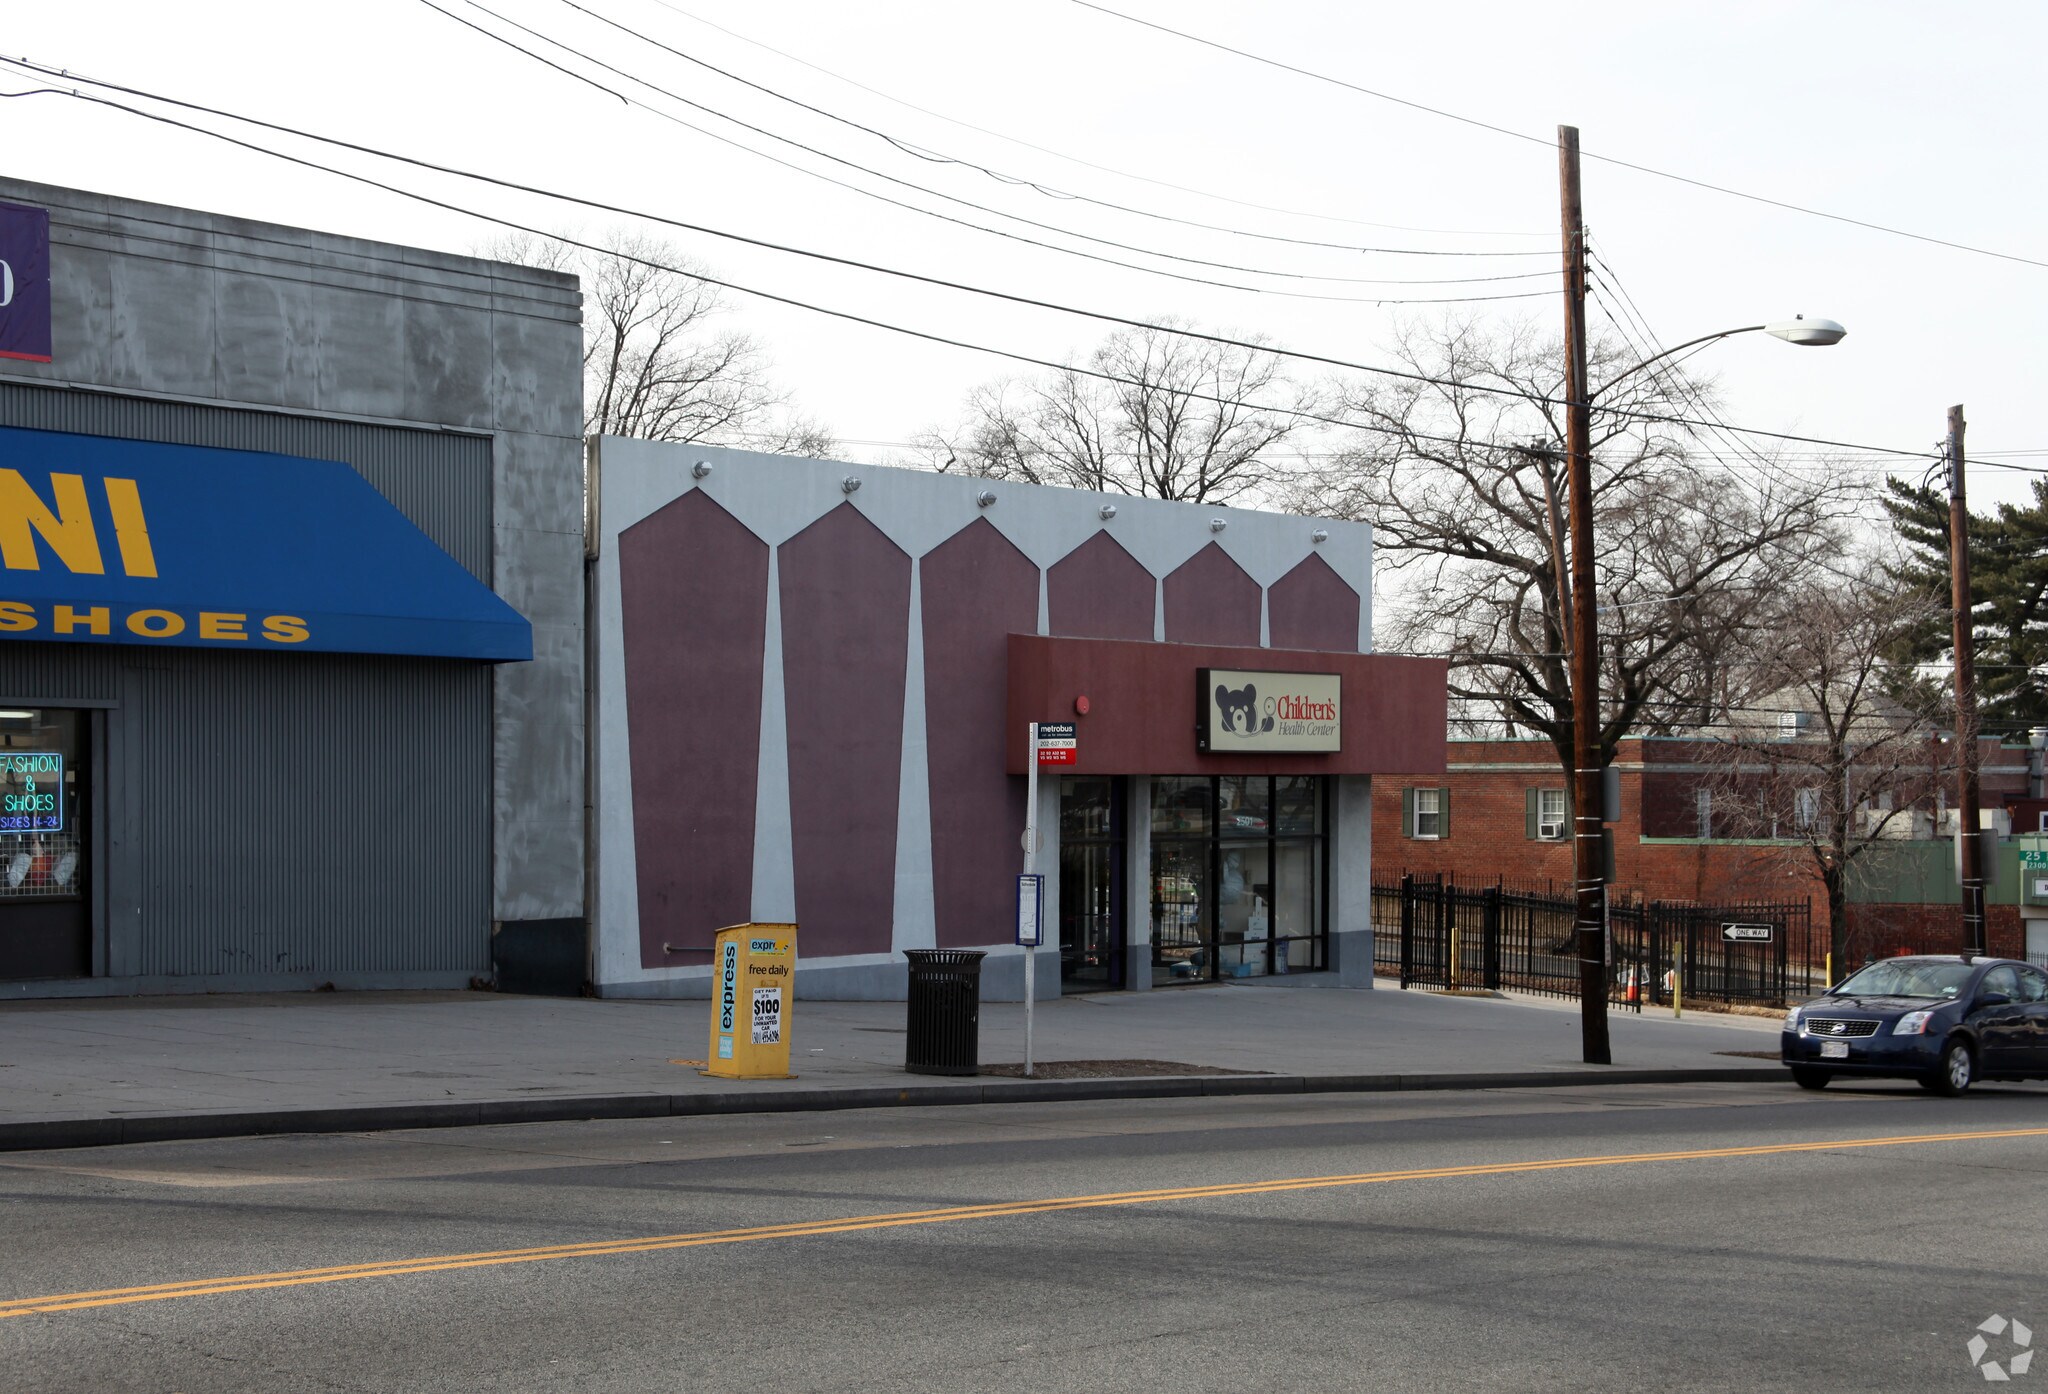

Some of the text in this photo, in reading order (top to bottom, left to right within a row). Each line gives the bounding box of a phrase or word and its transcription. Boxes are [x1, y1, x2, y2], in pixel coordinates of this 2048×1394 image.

[0, 468, 158, 578] NI
[0, 602, 310, 643] SHOES
[1278, 695, 1336, 721] Children's
[1040, 725, 1073, 733] metrobus
[1278, 721, 1336, 736] Health Center
[26, 775, 36, 792] &
[5, 794, 54, 812] SHOES
[0, 816, 30, 828] SIZES
[2026, 851, 2041, 861] 25
[749, 964, 789, 977] free daily
[722, 946, 736, 1029] express
[754, 998, 780, 1016] $100
